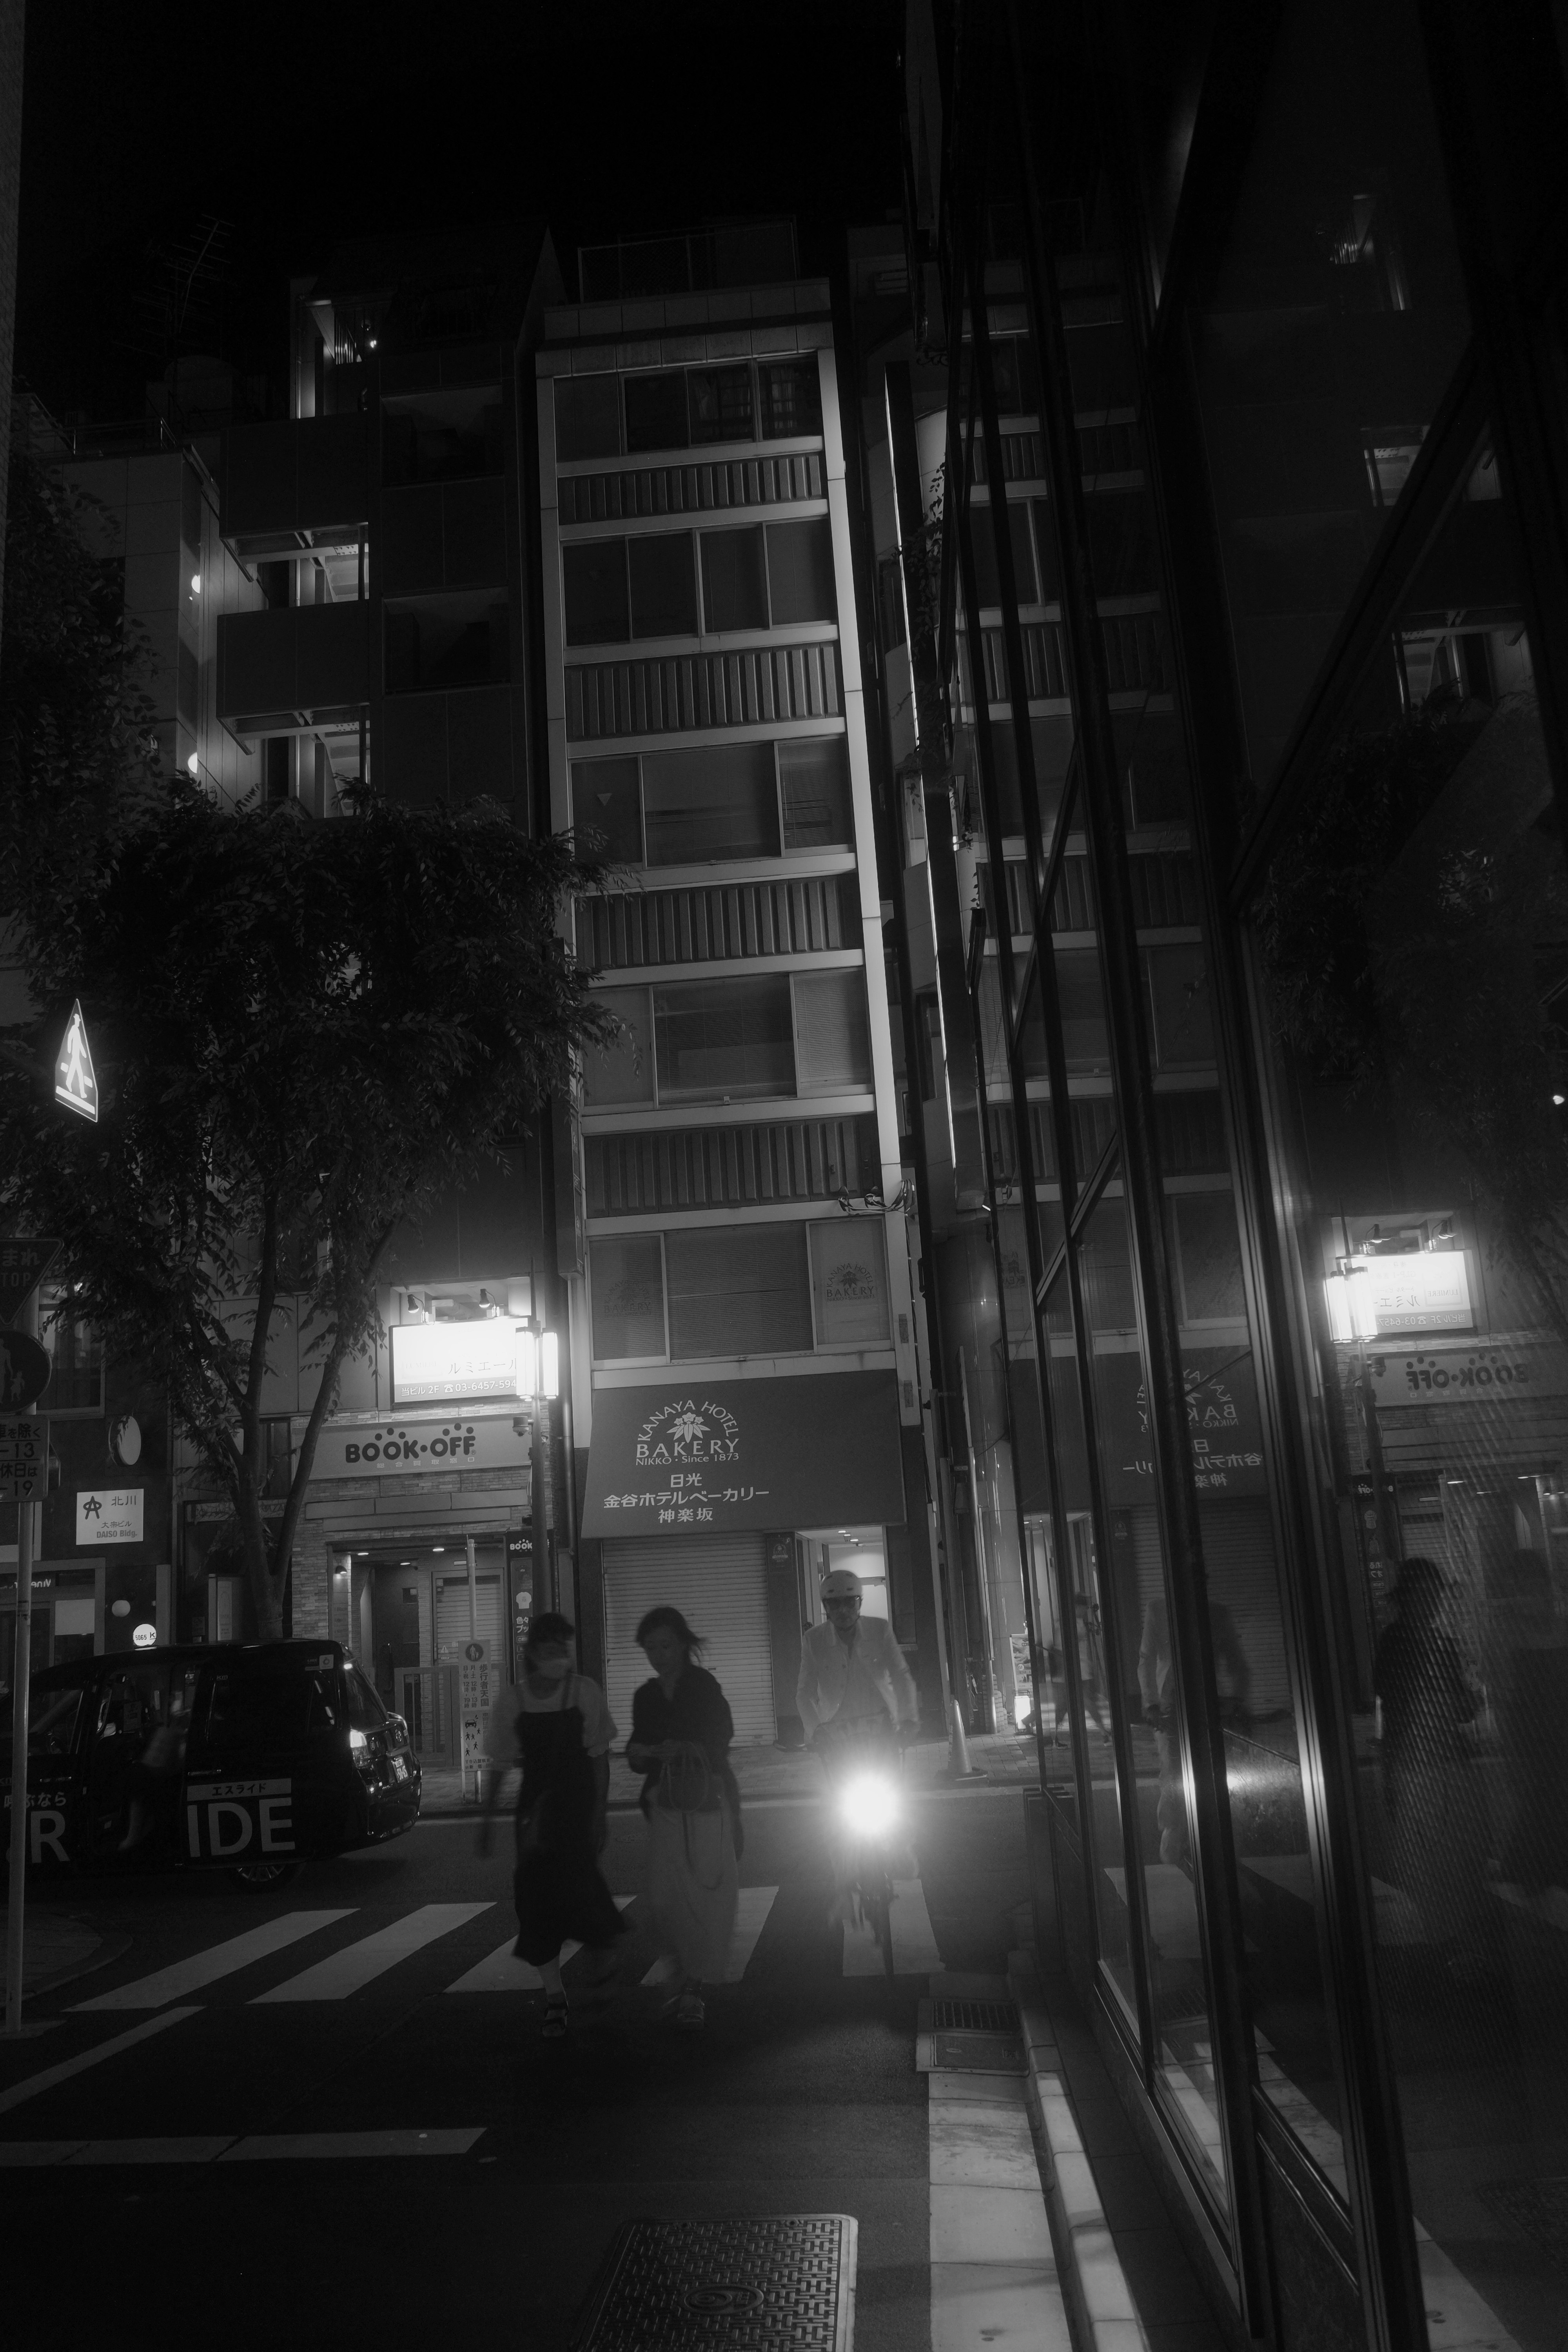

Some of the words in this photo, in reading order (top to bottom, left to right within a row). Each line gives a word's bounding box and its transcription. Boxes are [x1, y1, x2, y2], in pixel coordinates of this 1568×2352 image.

[2, 1248, 40, 1267] まれ
[827, 1263, 852, 1287] KANAYA
[855, 1264, 873, 1285] HOTEL
[827, 1286, 874, 1297] BAKERY
[401, 1387, 426, 1396] 当ビル
[428, 1385, 439, 1394] 2F
[637, 1400, 696, 1441] KANAYA
[701, 1401, 739, 1437] HOTEL
[636, 1439, 739, 1458] BAKERY
[636, 1457, 671, 1466] NIKKO
[714, 1453, 739, 1461] 1873
[670, 1473, 702, 1487] 日光
[111, 1495, 136, 1506] 北川
[604, 1487, 769, 1508] 金谷ホテルベーカリー
[658, 1508, 713, 1523] 神楽坂
[96, 1530, 118, 1538] DAISO
[120, 1530, 137, 1538] Bldg.
[479, 1664, 489, 1707] 歩行者天国
[212, 1783, 267, 1796] エスライド
